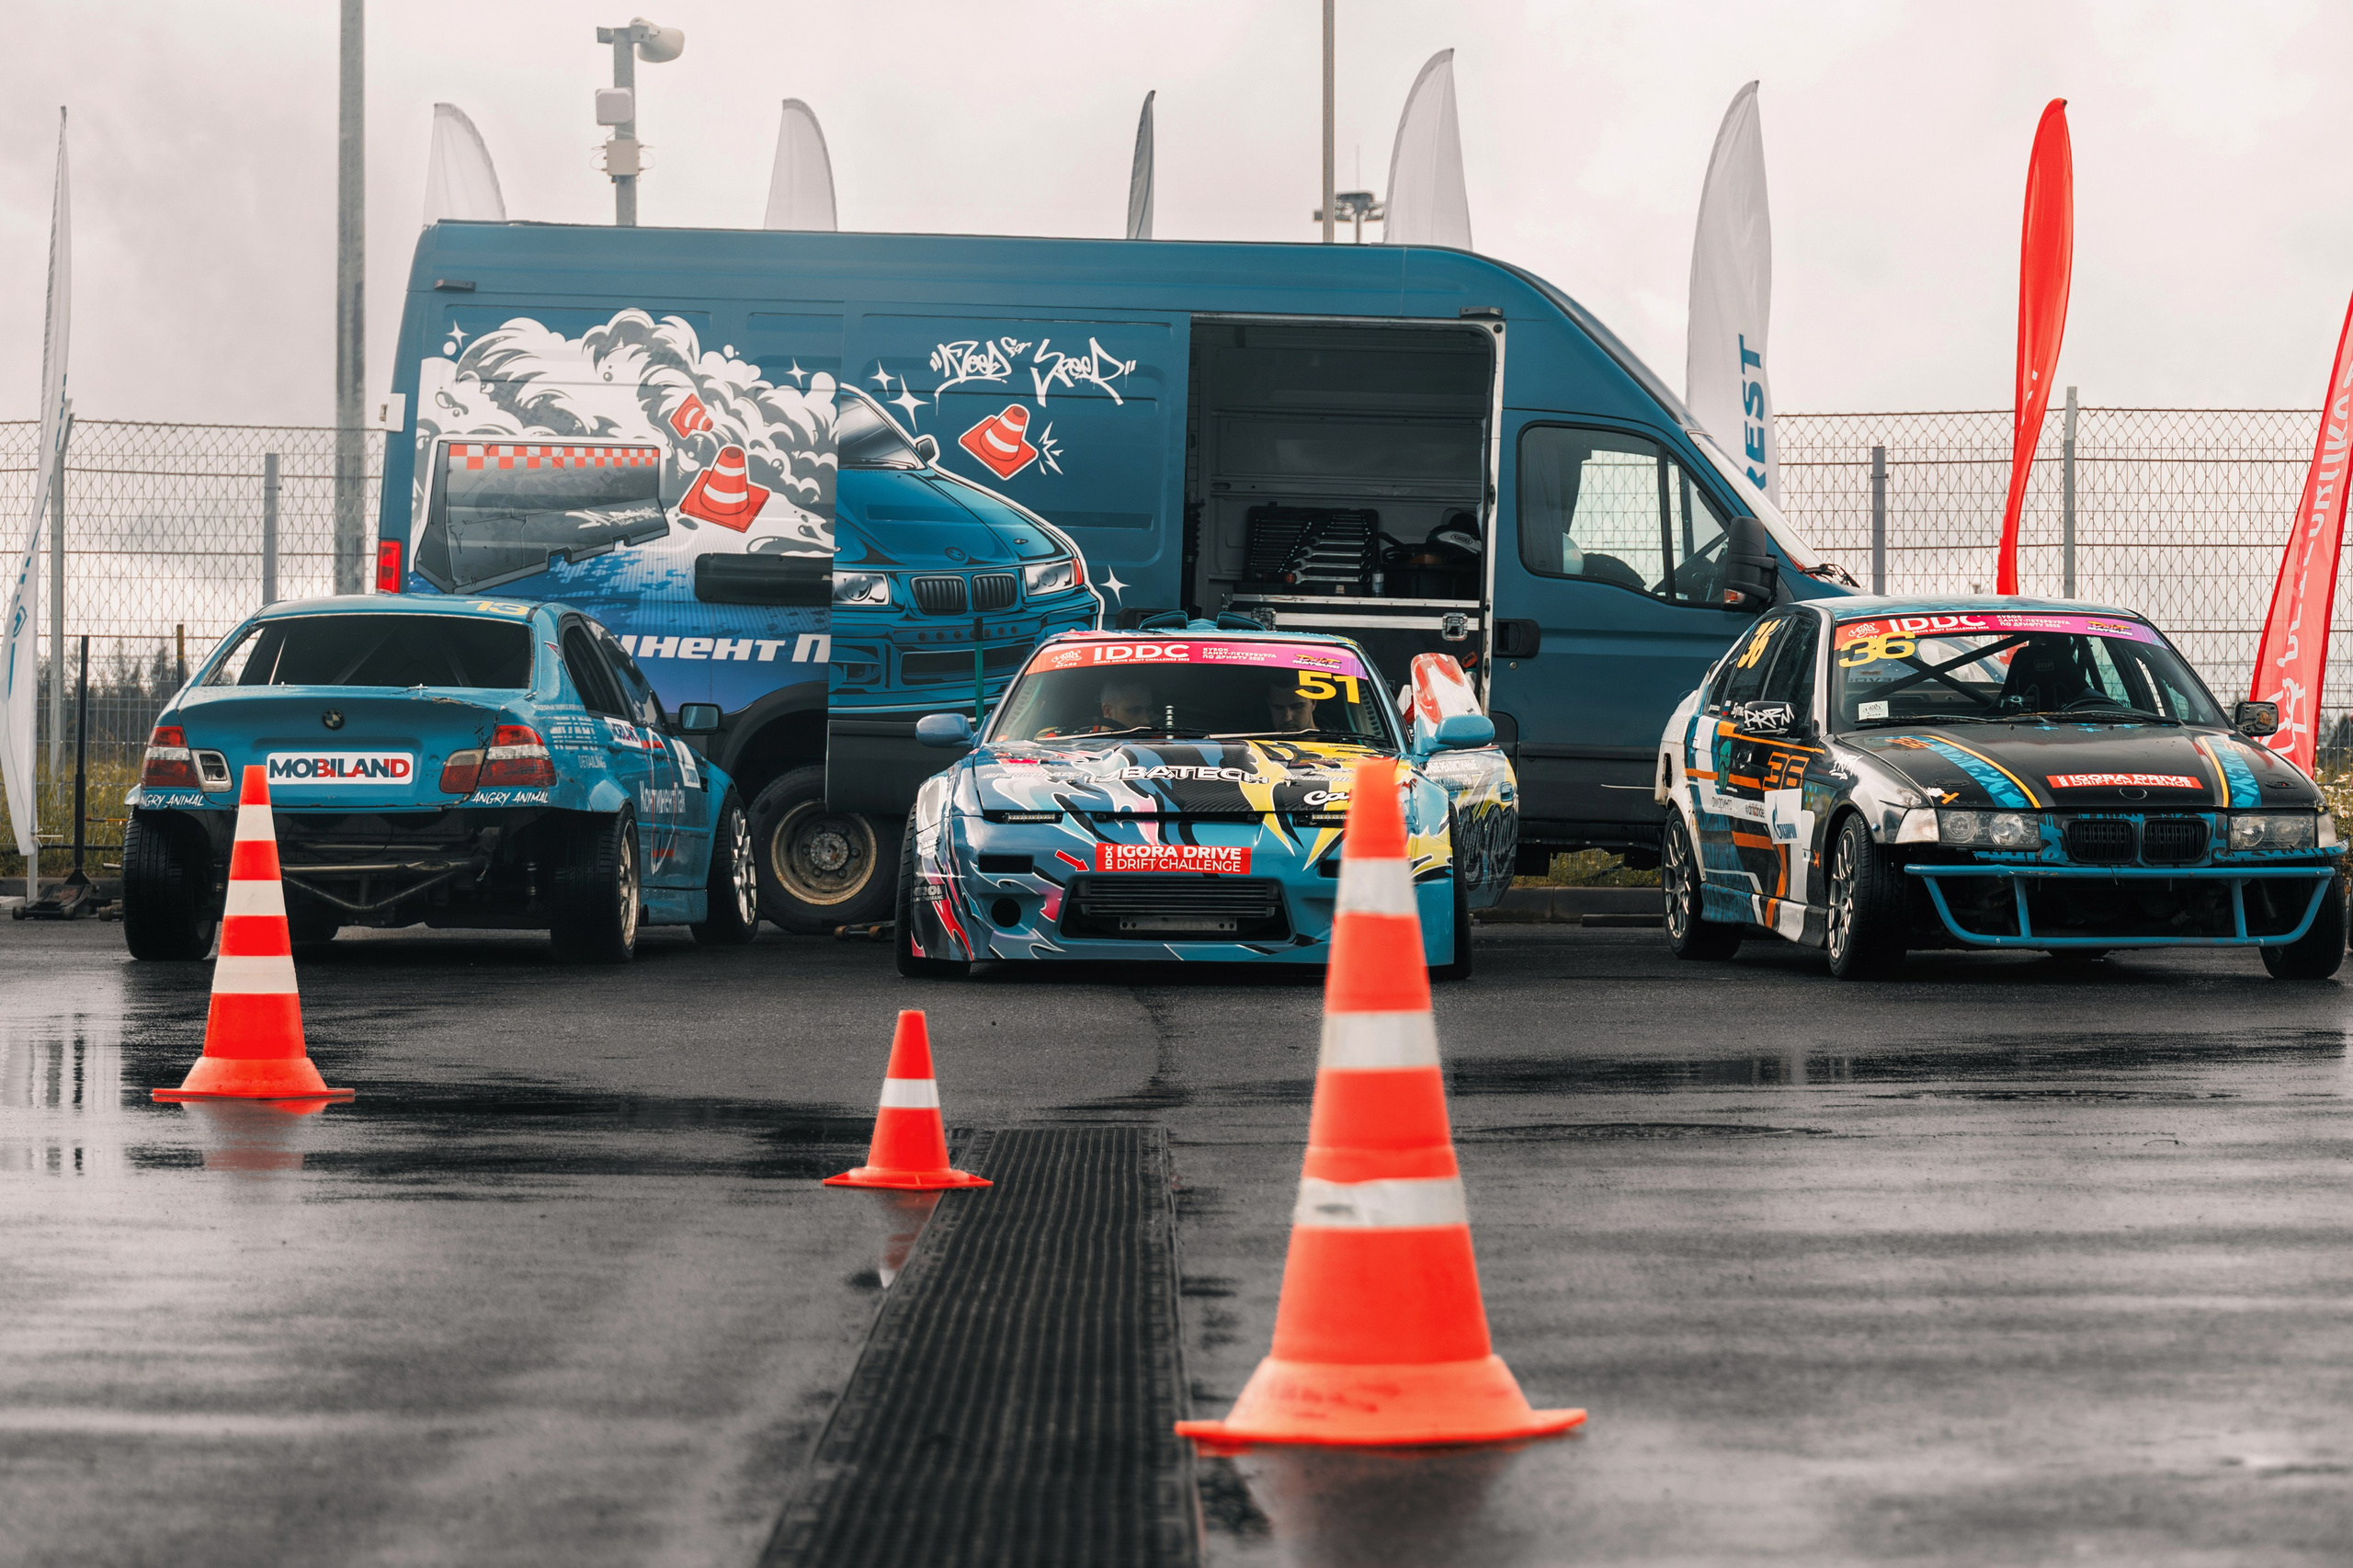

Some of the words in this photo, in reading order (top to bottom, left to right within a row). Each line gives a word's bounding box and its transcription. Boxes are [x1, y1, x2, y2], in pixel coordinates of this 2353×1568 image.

[466, 601, 530, 616] 13
[1889, 616, 1986, 632] IDDC
[1094, 644, 1190, 661] IDDC
[1737, 619, 1780, 669] 36
[1839, 631, 1915, 668] 36
[1295, 670, 1360, 704] 51
[269, 758, 410, 778] MOBILAND
[1762, 752, 1810, 791] 36
[141, 794, 165, 809] NGRY
[165, 794, 204, 806] ANIMAL
[471, 791, 511, 806] ANGRY
[512, 791, 549, 803] ANIMAL
[1105, 845, 1114, 869] IDDC
[1117, 845, 1178, 858] IGORA
[1183, 846, 1241, 860] DRIVE
[1117, 858, 1156, 869] DRIFT
[1159, 859, 1241, 872] CHALLENGE
